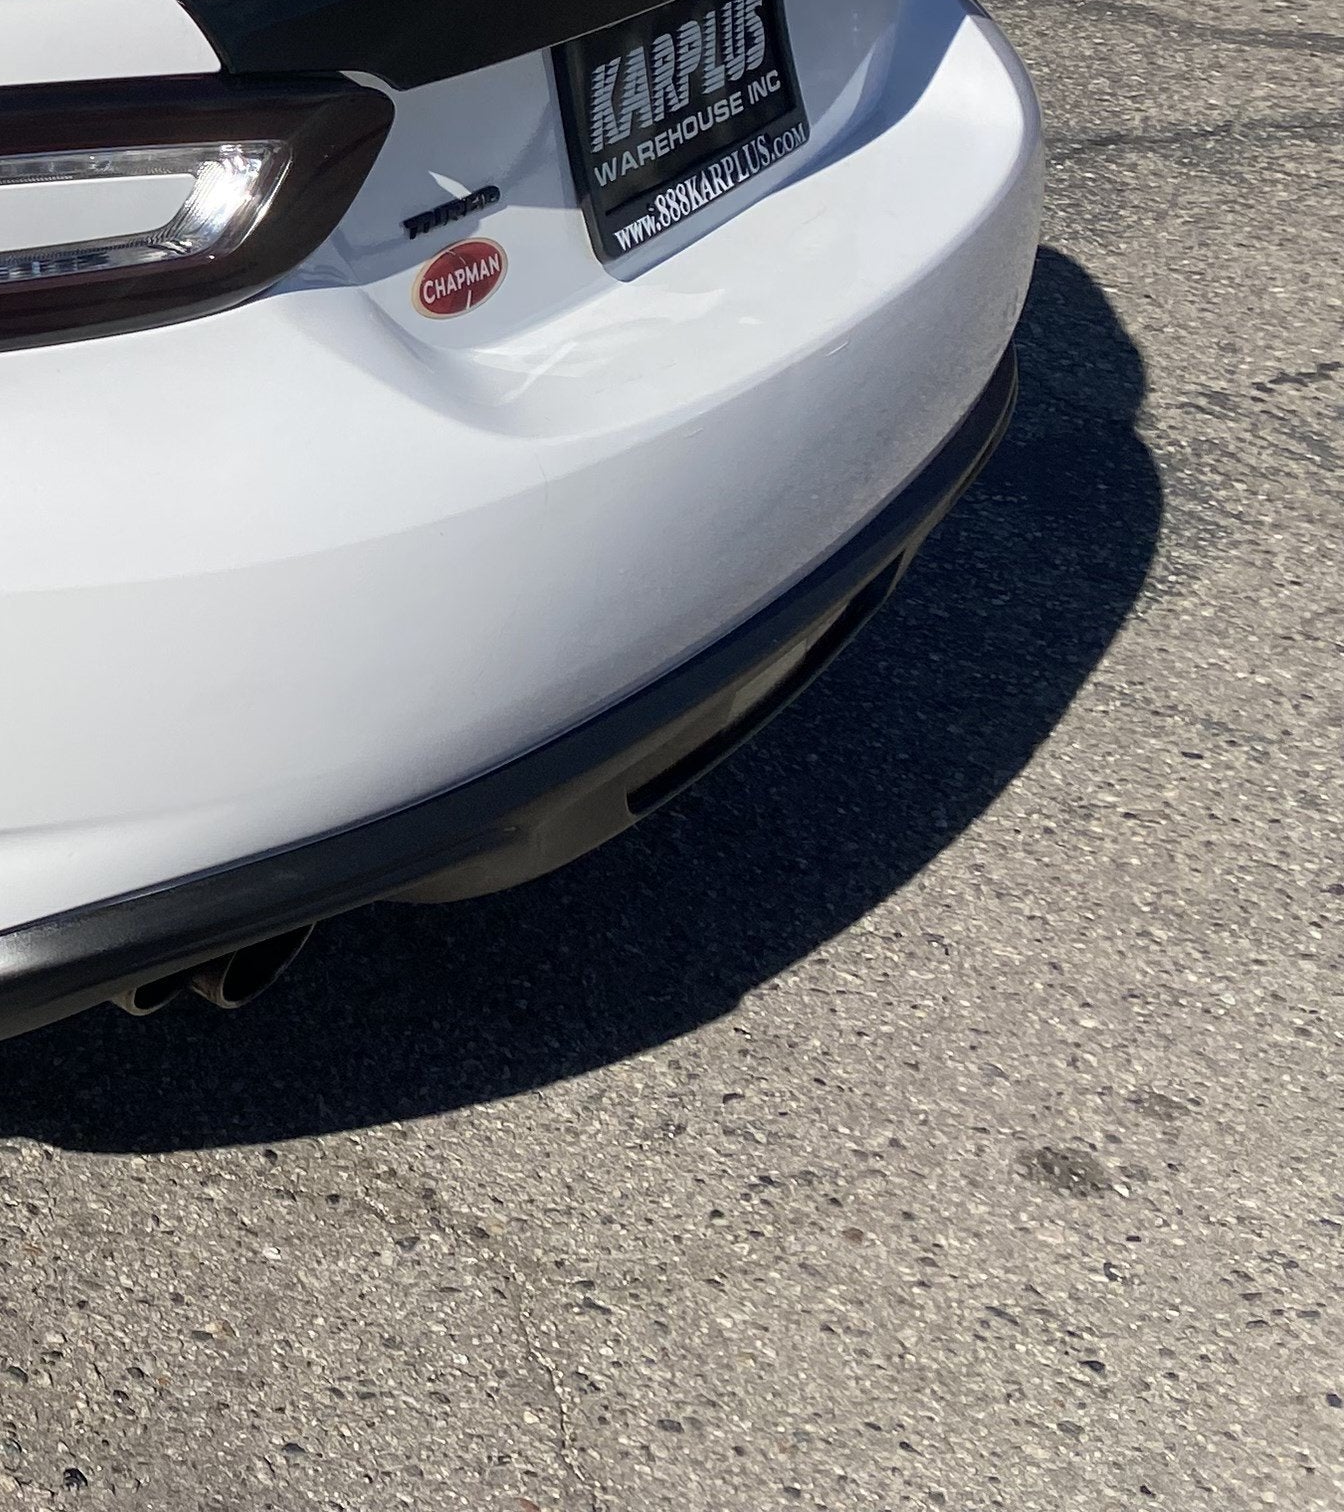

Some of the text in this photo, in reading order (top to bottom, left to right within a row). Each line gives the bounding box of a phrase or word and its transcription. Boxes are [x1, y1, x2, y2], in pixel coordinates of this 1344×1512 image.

[593, 68, 782, 187] WAREHOUSE INC
[422, 253, 501, 305] CHAPMAN
